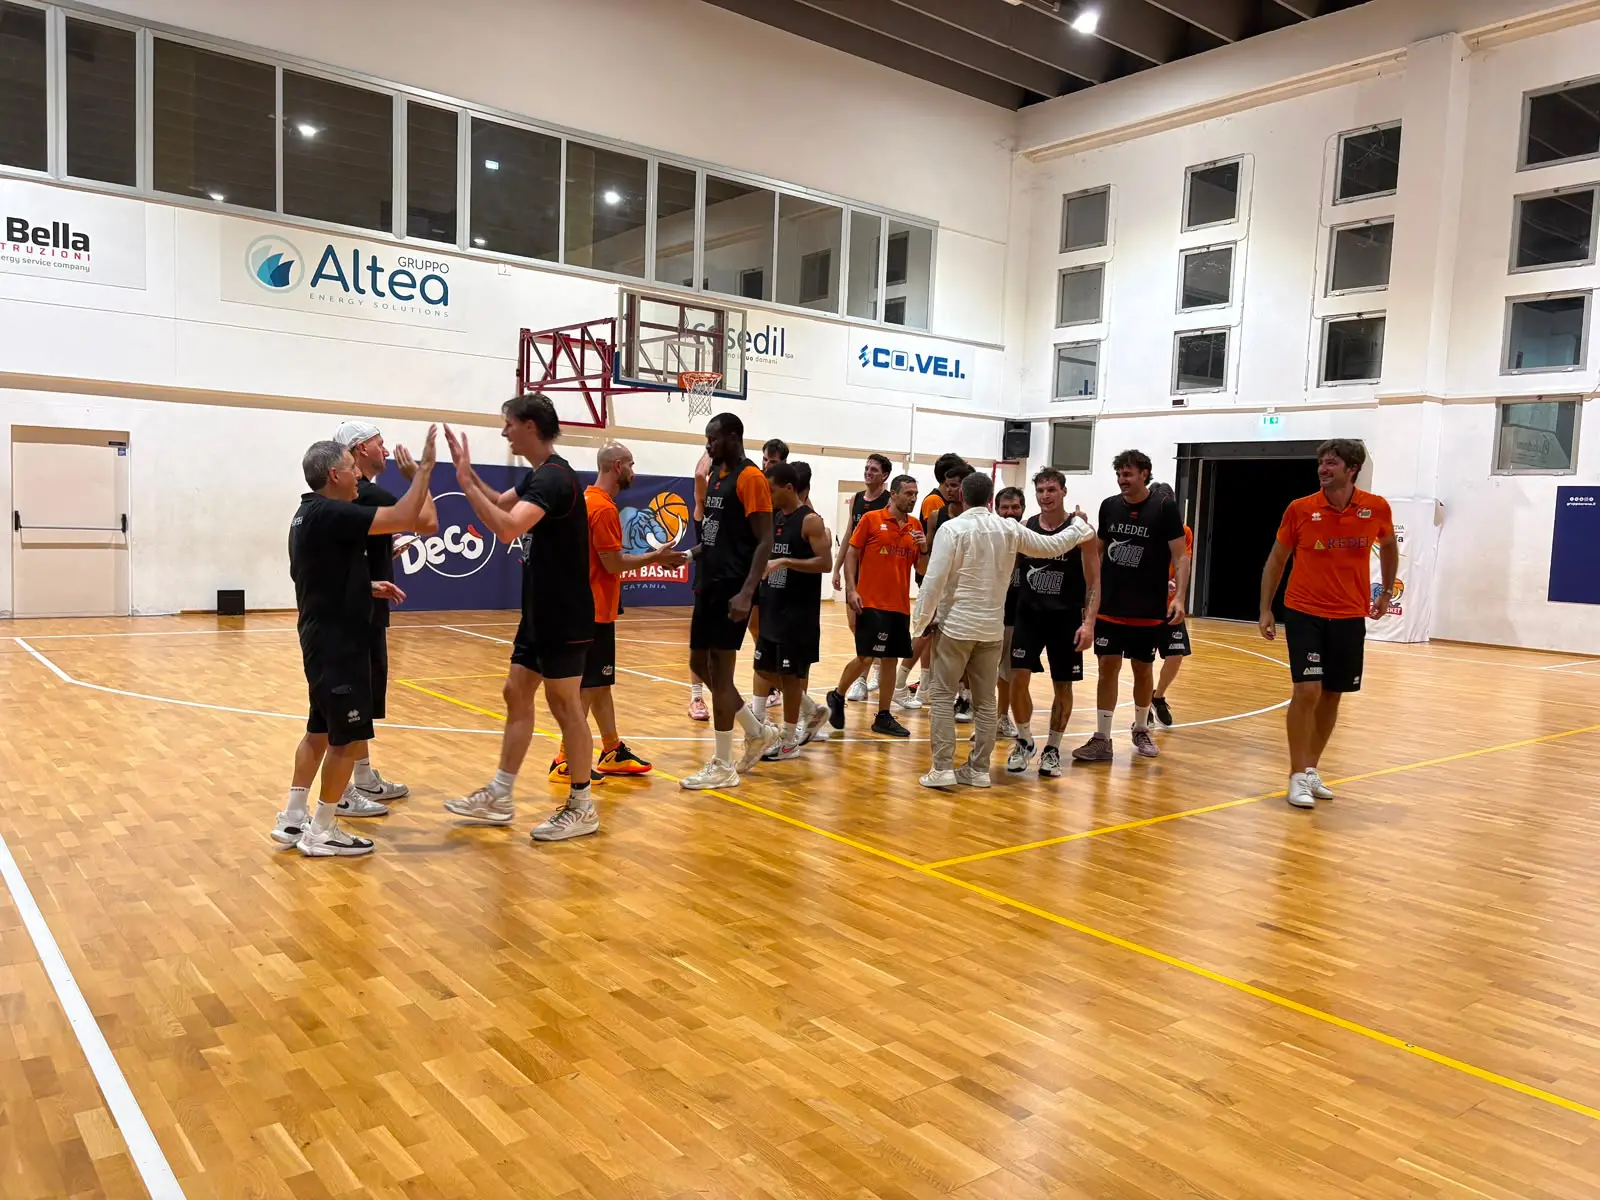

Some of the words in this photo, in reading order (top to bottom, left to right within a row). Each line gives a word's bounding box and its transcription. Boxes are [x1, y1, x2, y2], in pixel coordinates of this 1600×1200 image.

[6, 216, 90, 252] Bella
[0, 242, 91, 262] TRUZIONI
[22, 258, 52, 267] service
[53, 261, 91, 273] company
[310, 244, 449, 307] Altea
[397, 256, 450, 274] GRUPPO
[309, 292, 364, 306] ENERGY
[373, 301, 450, 318] SOLUTIONS
